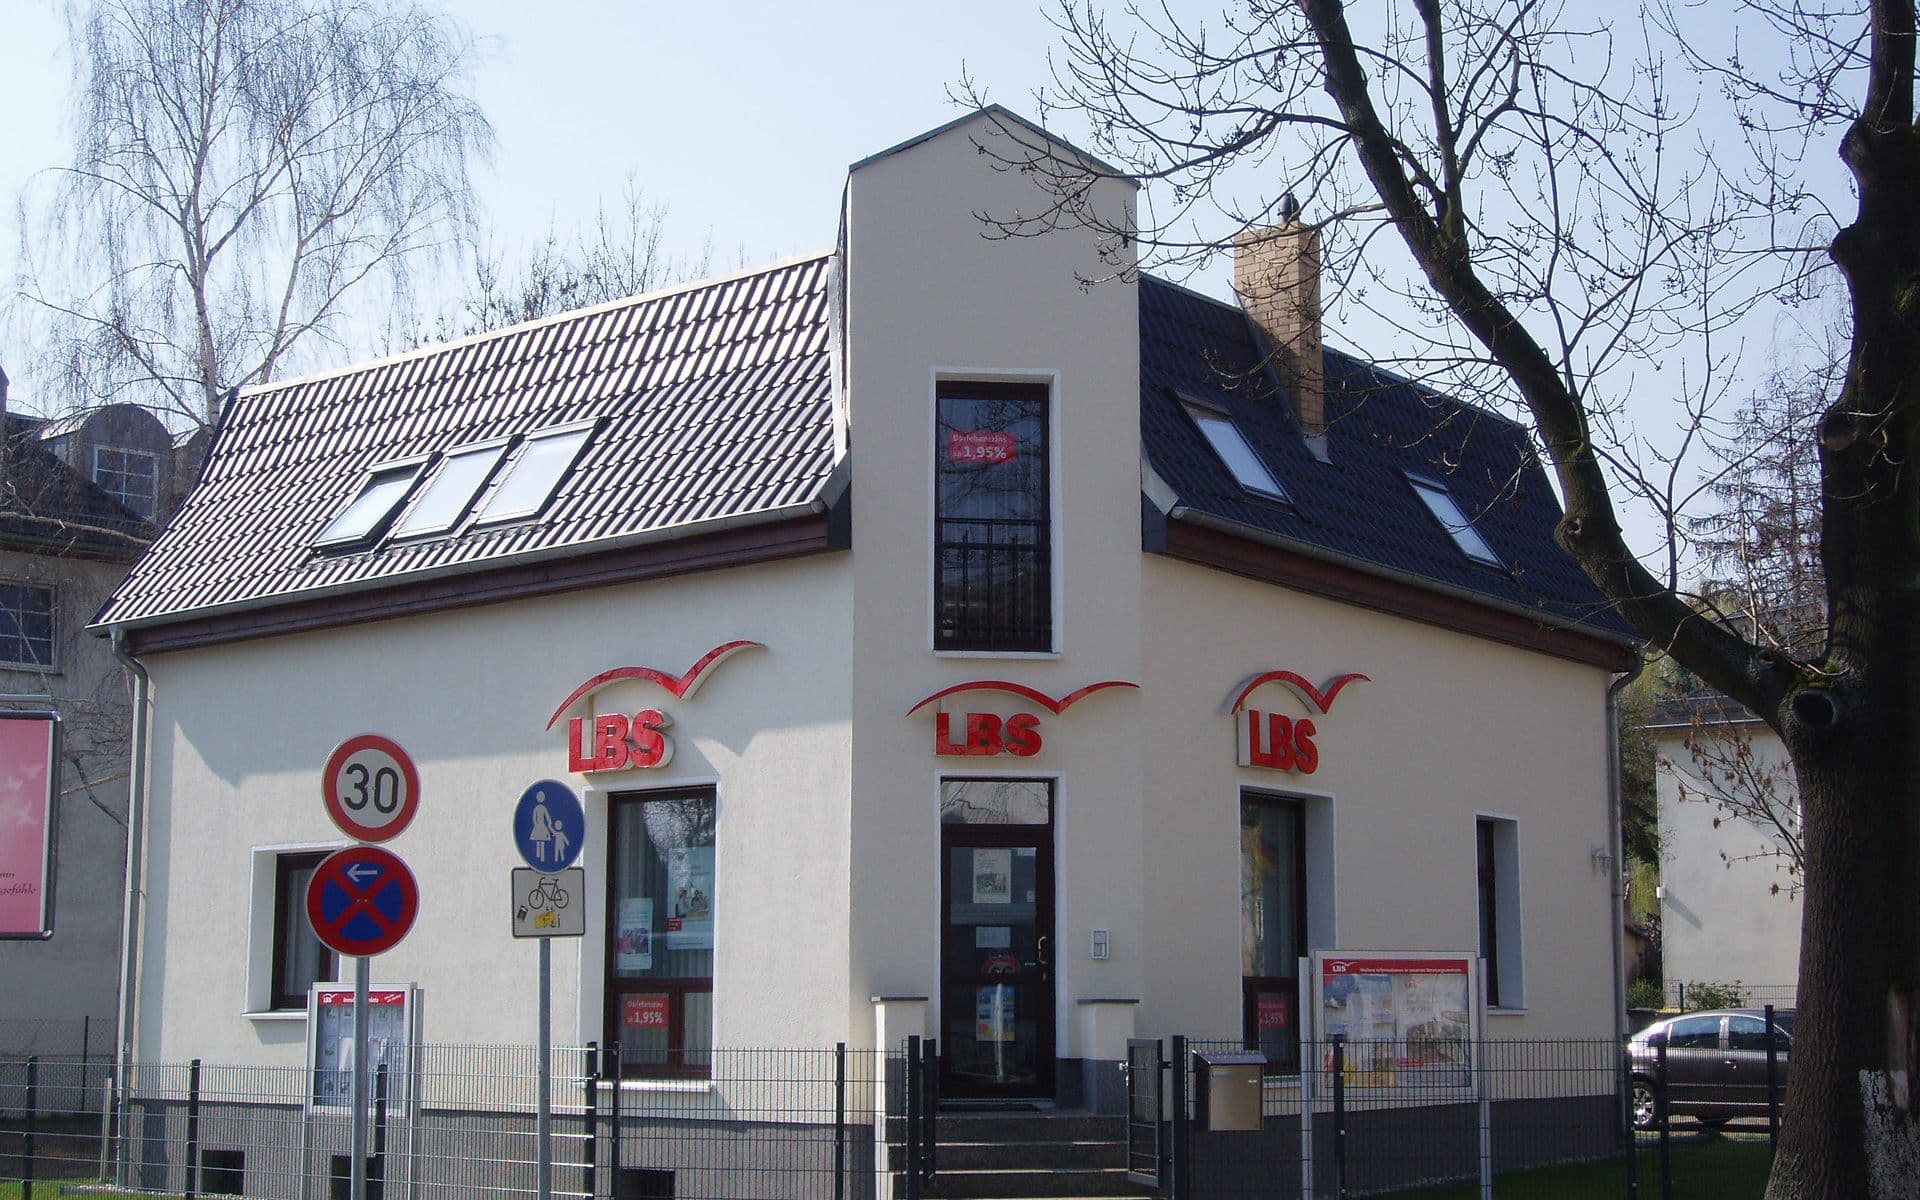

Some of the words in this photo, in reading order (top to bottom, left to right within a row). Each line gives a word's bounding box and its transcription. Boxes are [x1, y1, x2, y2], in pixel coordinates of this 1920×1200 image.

[963, 446, 1007, 460] 1,95%
[568, 708, 668, 773] LBS
[935, 712, 1042, 757] LBS
[1248, 709, 1319, 775] LBS
[344, 763, 399, 814] 30
[0, 882, 37, 897] gefühle
[634, 1011, 663, 1025] 1,95%
